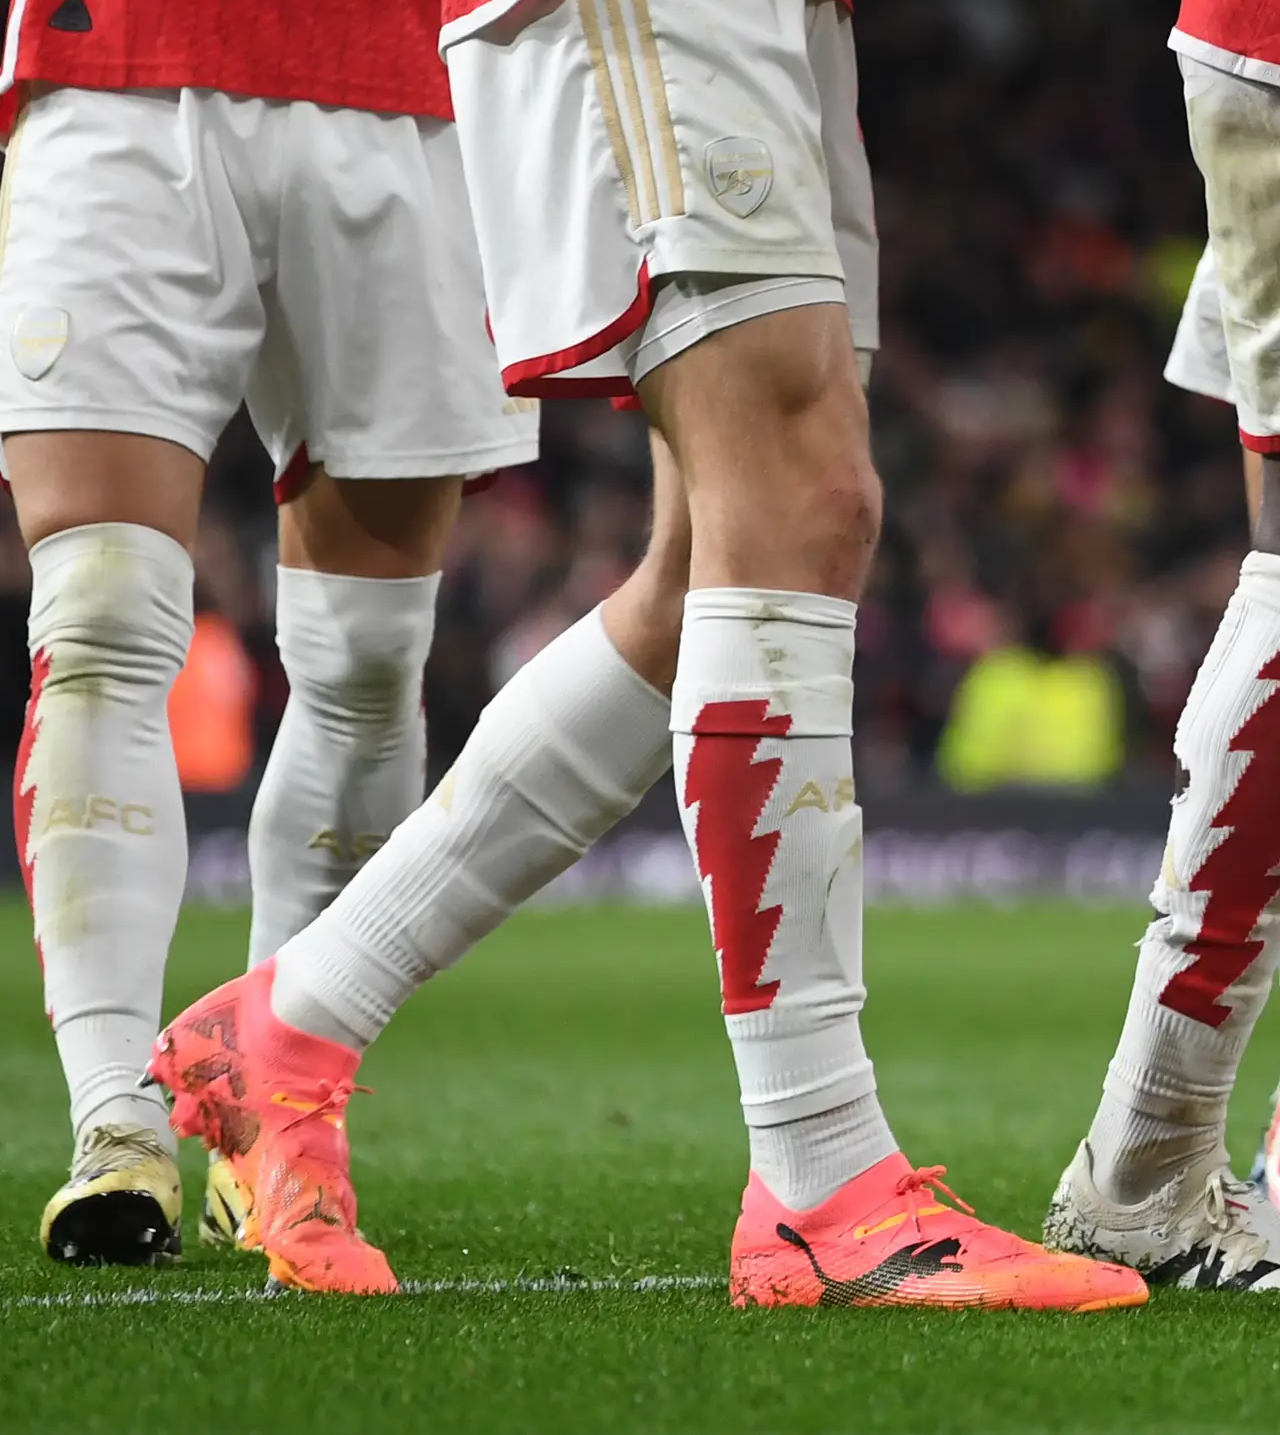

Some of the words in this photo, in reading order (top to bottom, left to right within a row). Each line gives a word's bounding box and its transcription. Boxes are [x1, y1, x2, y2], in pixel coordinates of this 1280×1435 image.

[43, 794, 154, 836] AFC
[784, 776, 855, 817] AF
[305, 824, 387, 862] AF
